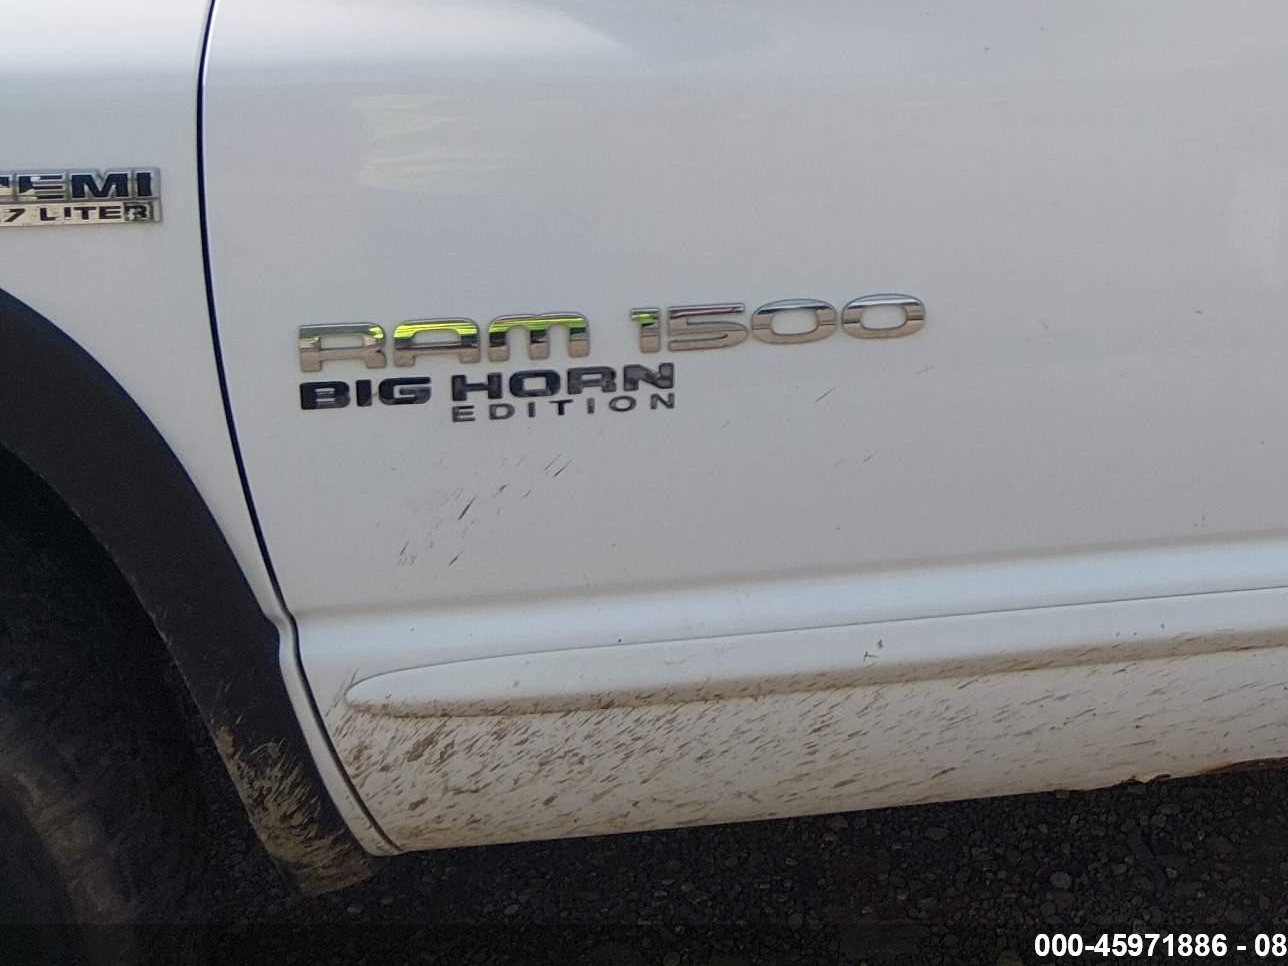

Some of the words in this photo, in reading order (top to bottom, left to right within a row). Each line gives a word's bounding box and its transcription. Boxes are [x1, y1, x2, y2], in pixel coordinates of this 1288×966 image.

[0, 170, 156, 200] EMI
[0, 208, 26, 222] 7
[298, 313, 591, 372] RAM
[630, 293, 926, 354] 1500
[300, 376, 432, 410] BIG
[450, 362, 675, 401] HORN
[451, 392, 676, 422] EDITION
